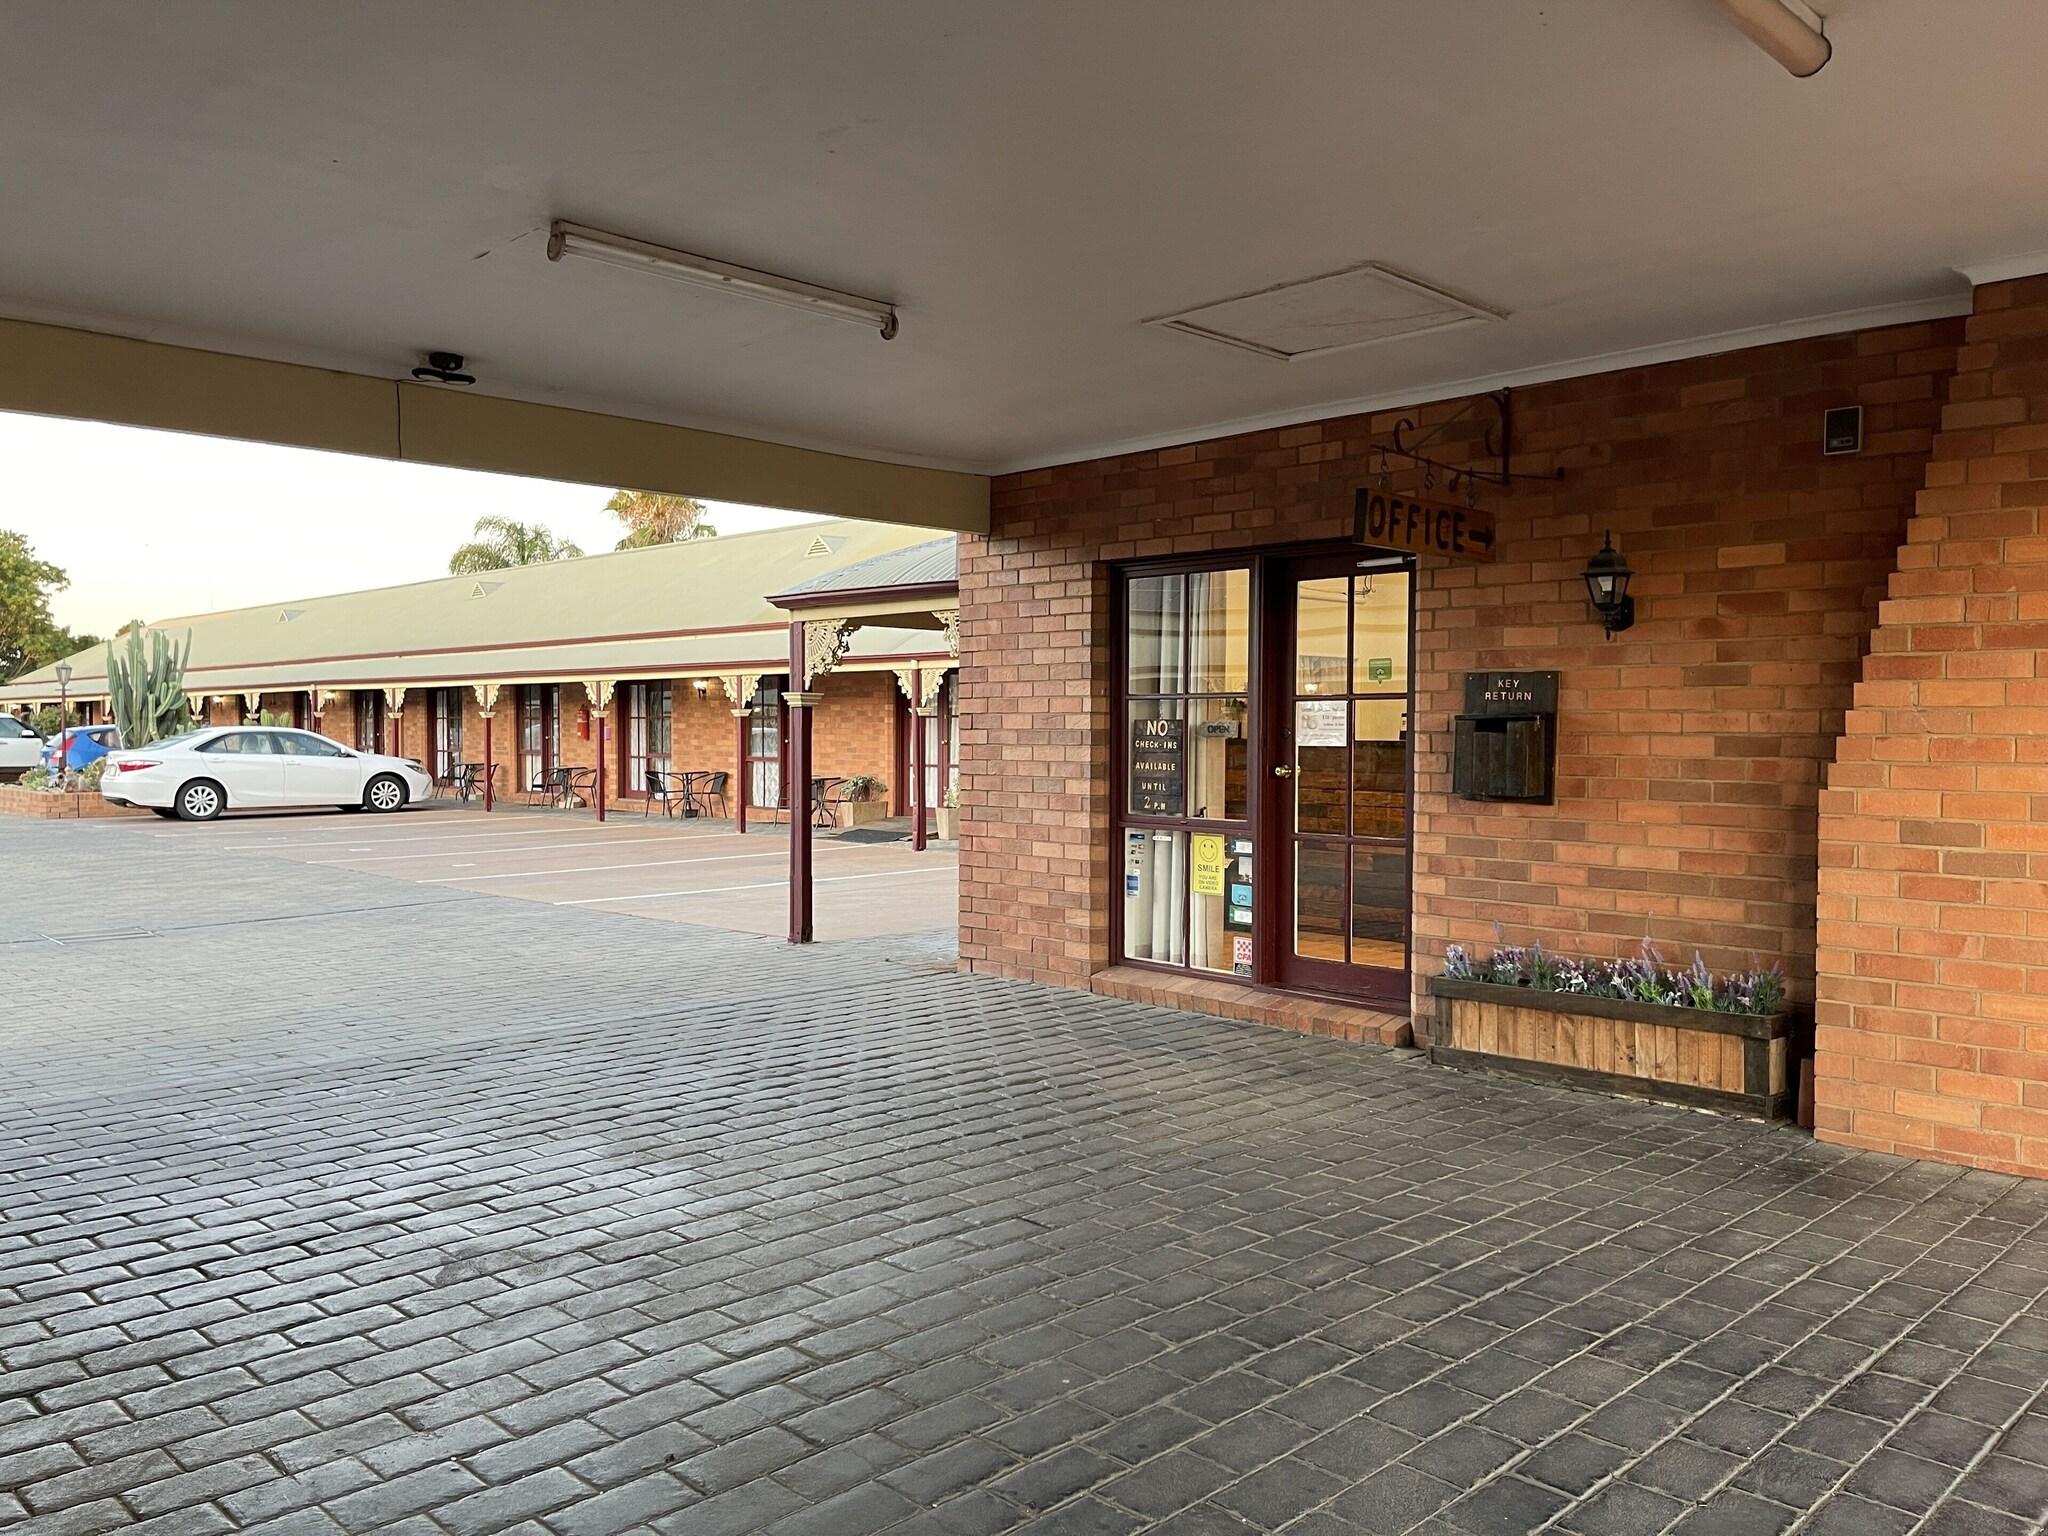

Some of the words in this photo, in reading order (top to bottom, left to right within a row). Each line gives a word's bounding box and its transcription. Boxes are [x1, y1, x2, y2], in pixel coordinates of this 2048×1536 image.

[1368, 495, 1466, 552] OFFICE
[1497, 679, 1520, 688] KEY
[1484, 691, 1532, 701] RETURN
[1146, 720, 1168, 736] NO
[1207, 724, 1230, 734] OPEN
[1135, 740, 1177, 749] CHECK-INS
[1135, 762, 1176, 771] AVAILABLE
[1141, 782, 1166, 791] UNTIL
[1143, 796, 1151, 809] 2
[1197, 863, 1220, 873] SMILE
